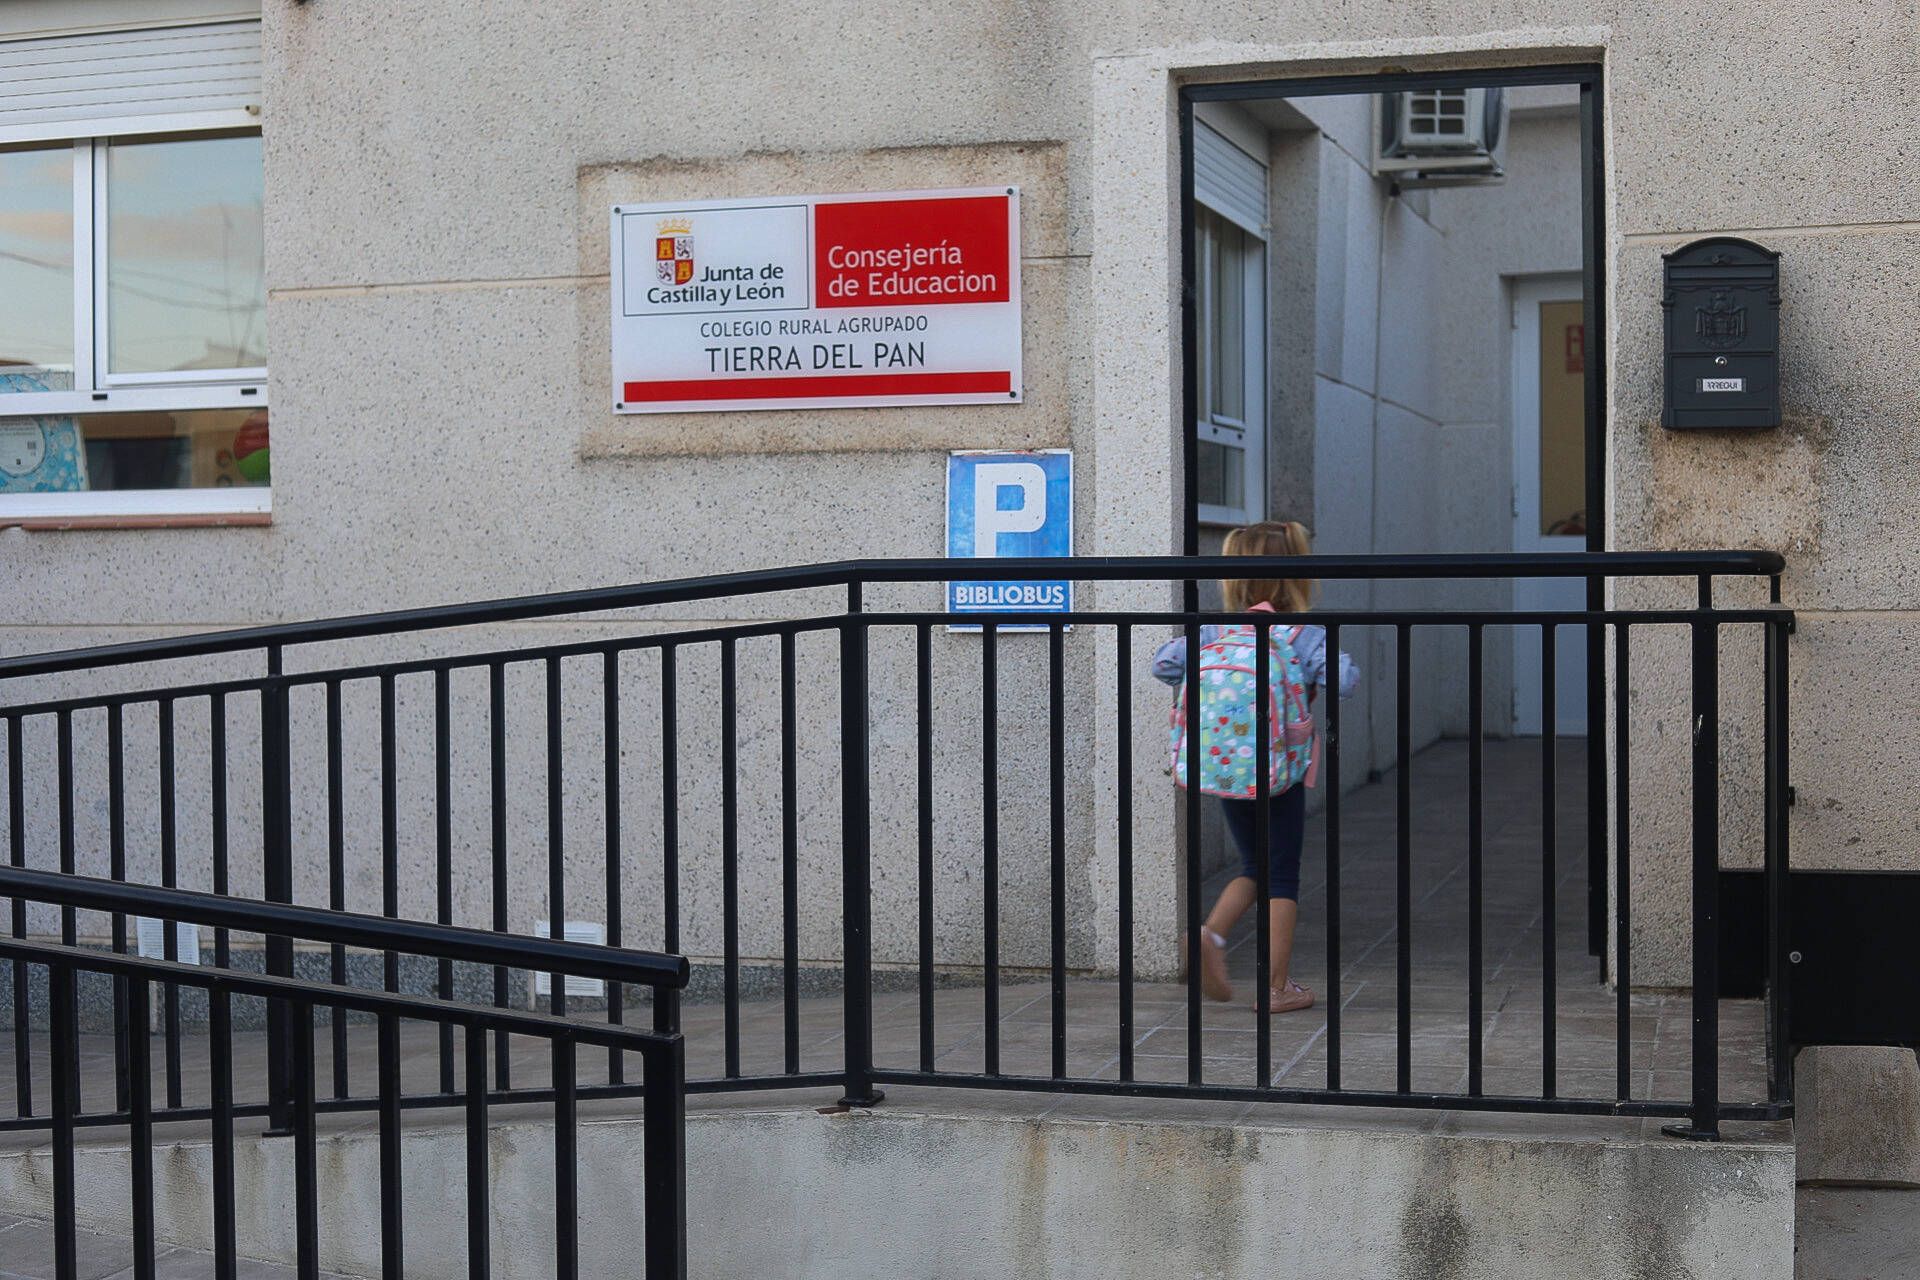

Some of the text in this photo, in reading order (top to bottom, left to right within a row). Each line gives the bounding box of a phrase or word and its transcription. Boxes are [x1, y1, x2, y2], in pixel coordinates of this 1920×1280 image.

[828, 239, 963, 272] Consejería
[700, 263, 784, 282] Junta de
[828, 270, 997, 297] de Educacion
[647, 282, 784, 306] Castilla y León
[700, 315, 928, 338] COLEGIO RURAL AGRUPADO
[704, 341, 925, 373] TIERRA DEL PAN
[974, 462, 1047, 558] P
[955, 585, 1065, 605] BIBLIOBUS
